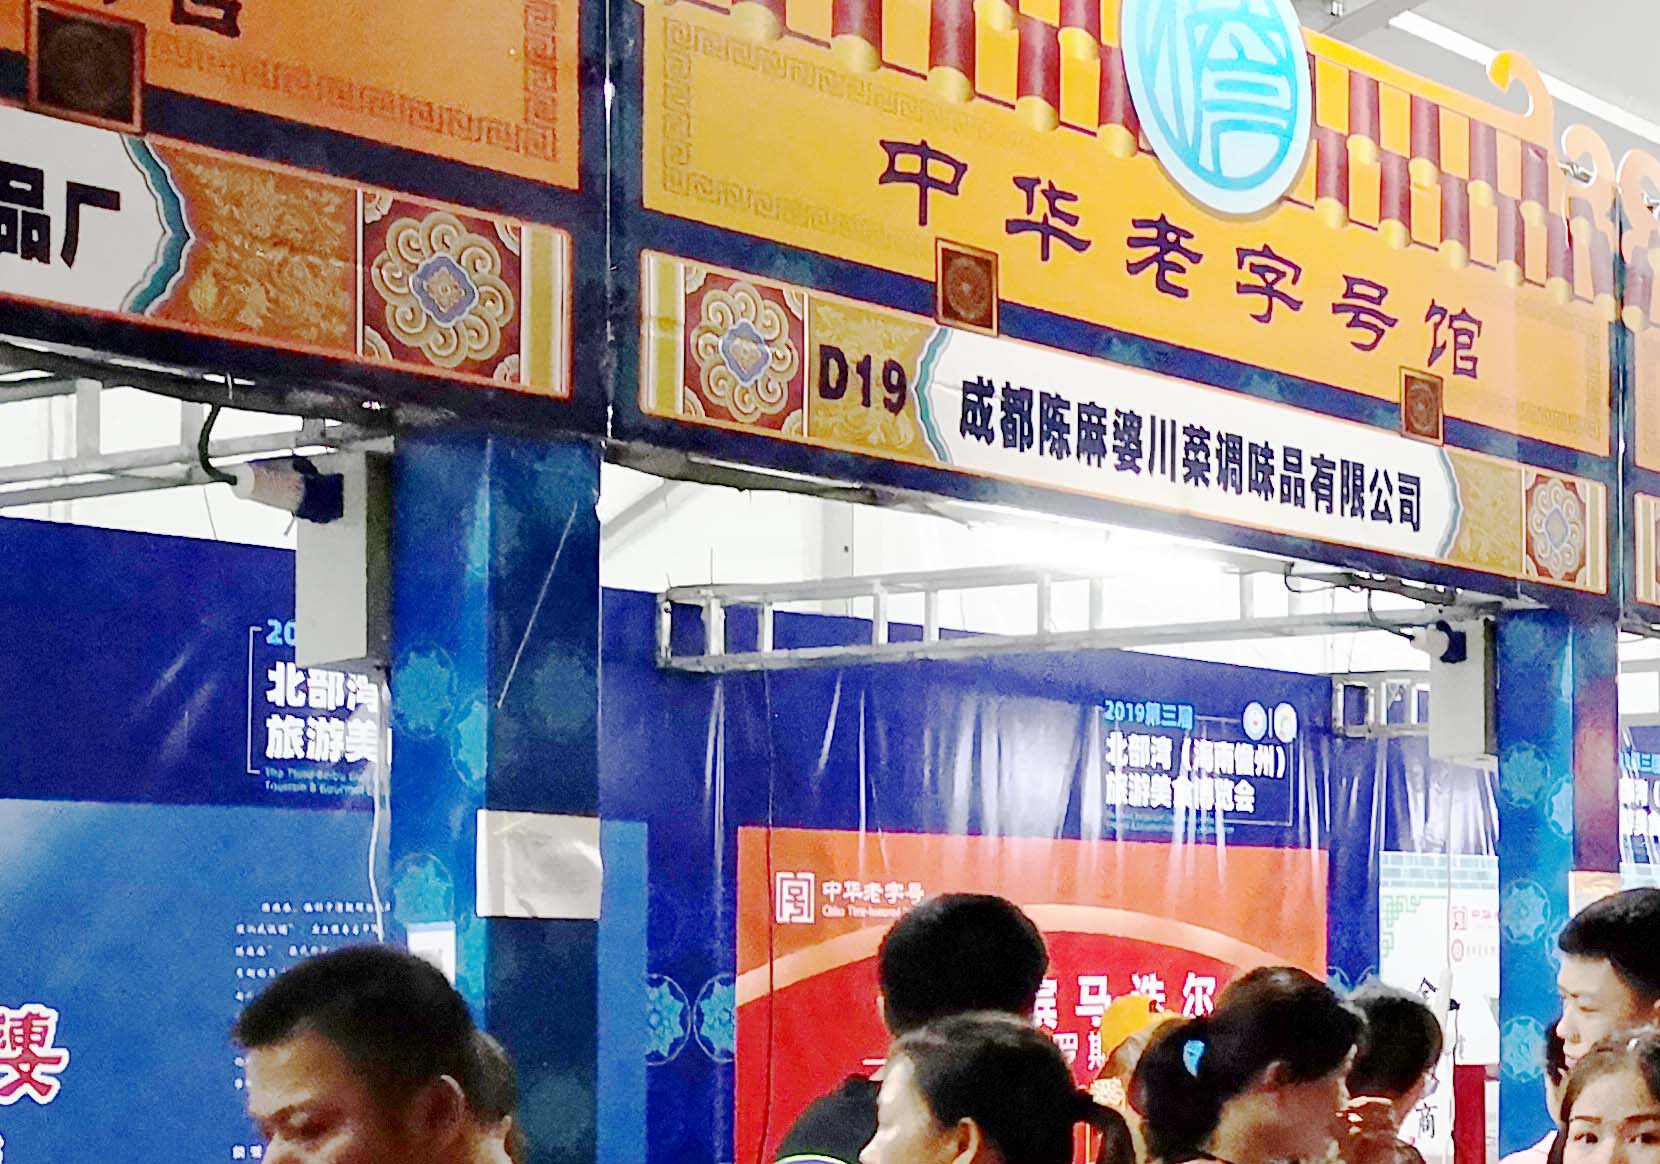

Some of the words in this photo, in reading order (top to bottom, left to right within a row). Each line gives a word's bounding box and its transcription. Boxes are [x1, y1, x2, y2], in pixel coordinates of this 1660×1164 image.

[878, 139, 1482, 379] 中华老字号馆
[818, 345, 908, 413] D19
[960, 376, 1421, 533] 成都陈麻婆川菜调味品有限公司
[821, 879, 925, 904] 中华老字号
